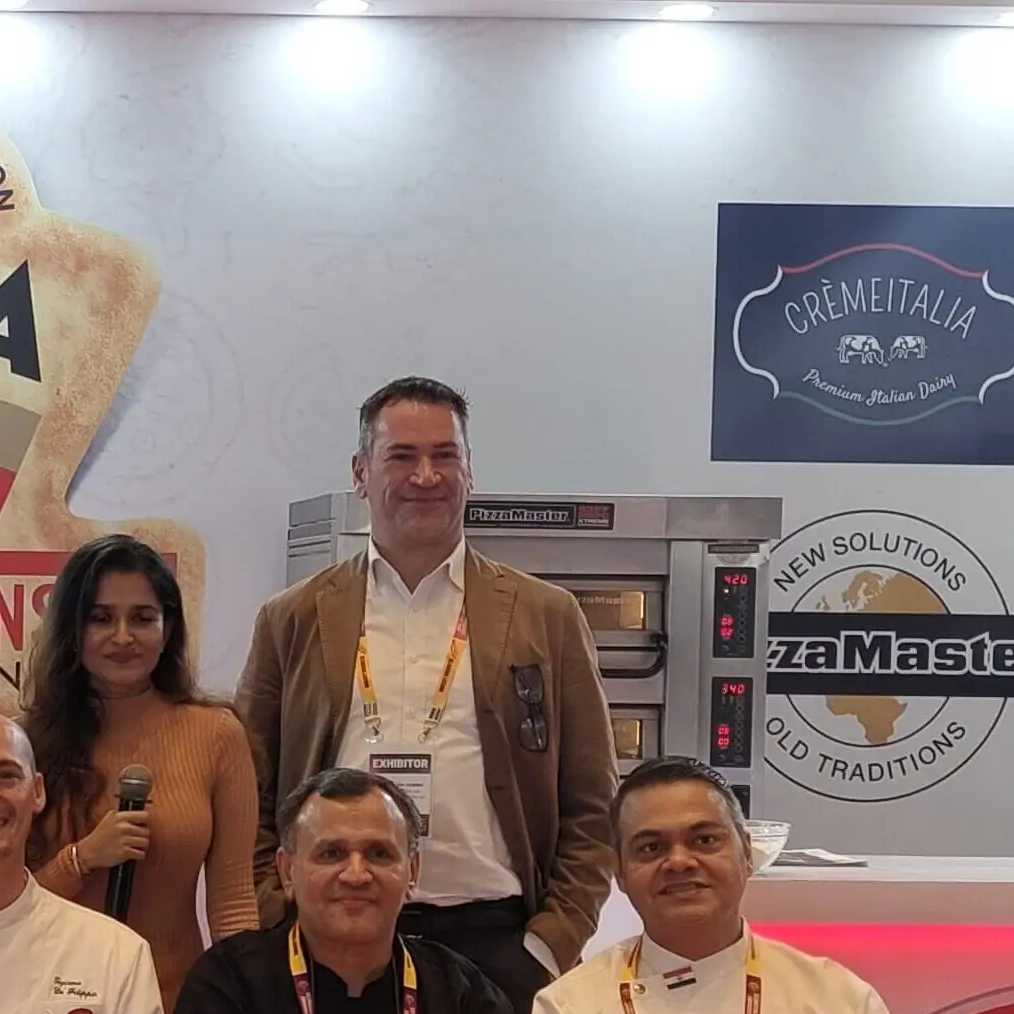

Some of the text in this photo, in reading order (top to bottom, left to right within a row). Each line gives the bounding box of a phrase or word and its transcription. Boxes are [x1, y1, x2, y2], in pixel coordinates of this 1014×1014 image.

[784, 277, 977, 339] CRÈMEITALIA
[802, 368, 956, 406] Premium Italian Dairy
[469, 507, 570, 521] PizzaMaster
[773, 531, 967, 592] NEW SOLUTIONS
[724, 574, 747, 585] 420
[721, 684, 745, 694] 340
[766, 717, 966, 783] OLD TRADITIONS
[372, 758, 429, 769] EXHIBITOR
